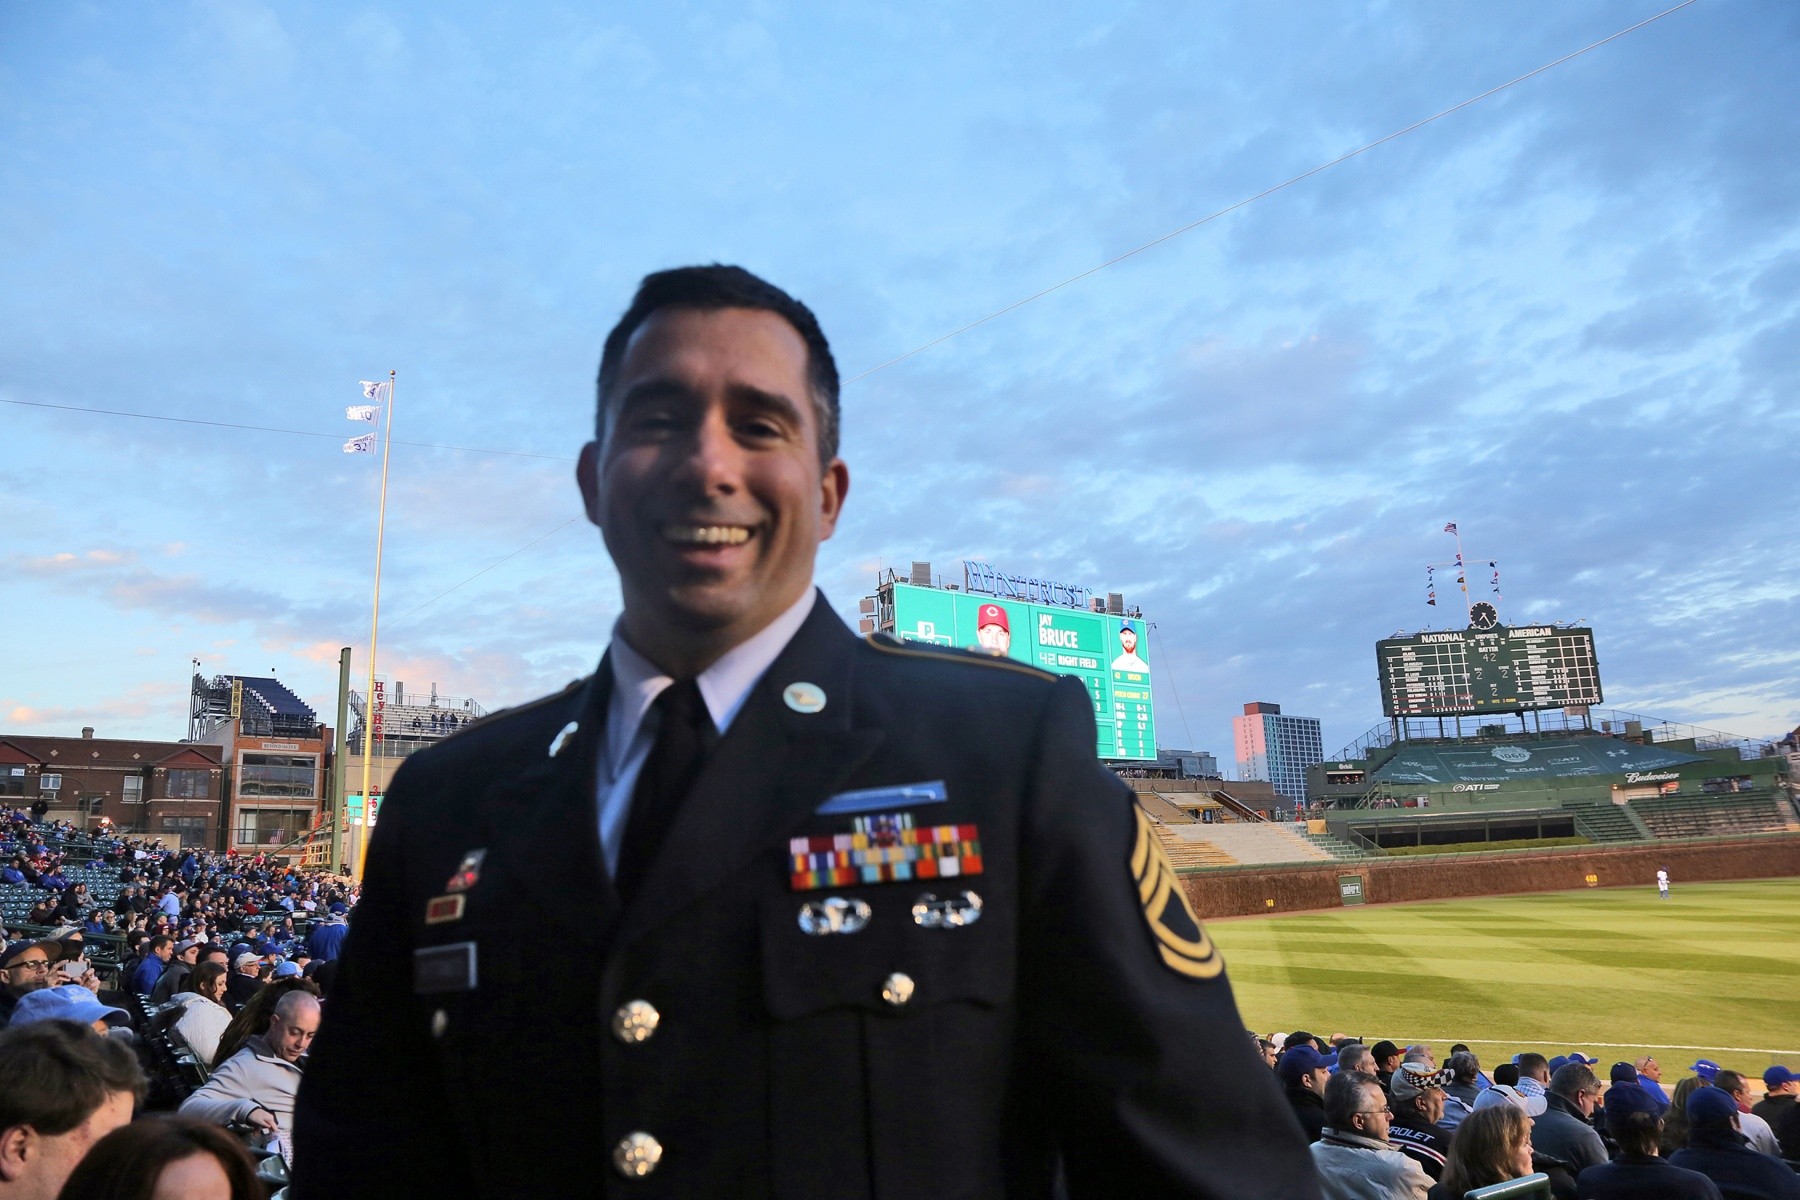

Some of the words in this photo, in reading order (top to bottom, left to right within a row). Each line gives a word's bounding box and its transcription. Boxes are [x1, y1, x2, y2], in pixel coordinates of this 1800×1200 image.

[963, 560, 1093, 609] WINTRUST
[1039, 614, 1052, 626] JAY
[1039, 628, 1078, 648] BRUCE
[1421, 633, 1465, 643] NATIONAL
[1509, 628, 1552, 638] AMERICAN
[1040, 652, 1056, 666] 42
[1058, 654, 1078, 667] RIGHT
[1080, 657, 1097, 669] FIELD
[1483, 653, 1496, 662] 42
[1501, 670, 1508, 678] 2
[1094, 678, 1099, 688] 2
[374, 682, 385, 712] Hey
[1491, 688, 1498, 696] 2
[373, 714, 383, 743] Hey
[1625, 771, 1680, 783] Budweiser
[1585, 874, 1597, 882] 400
